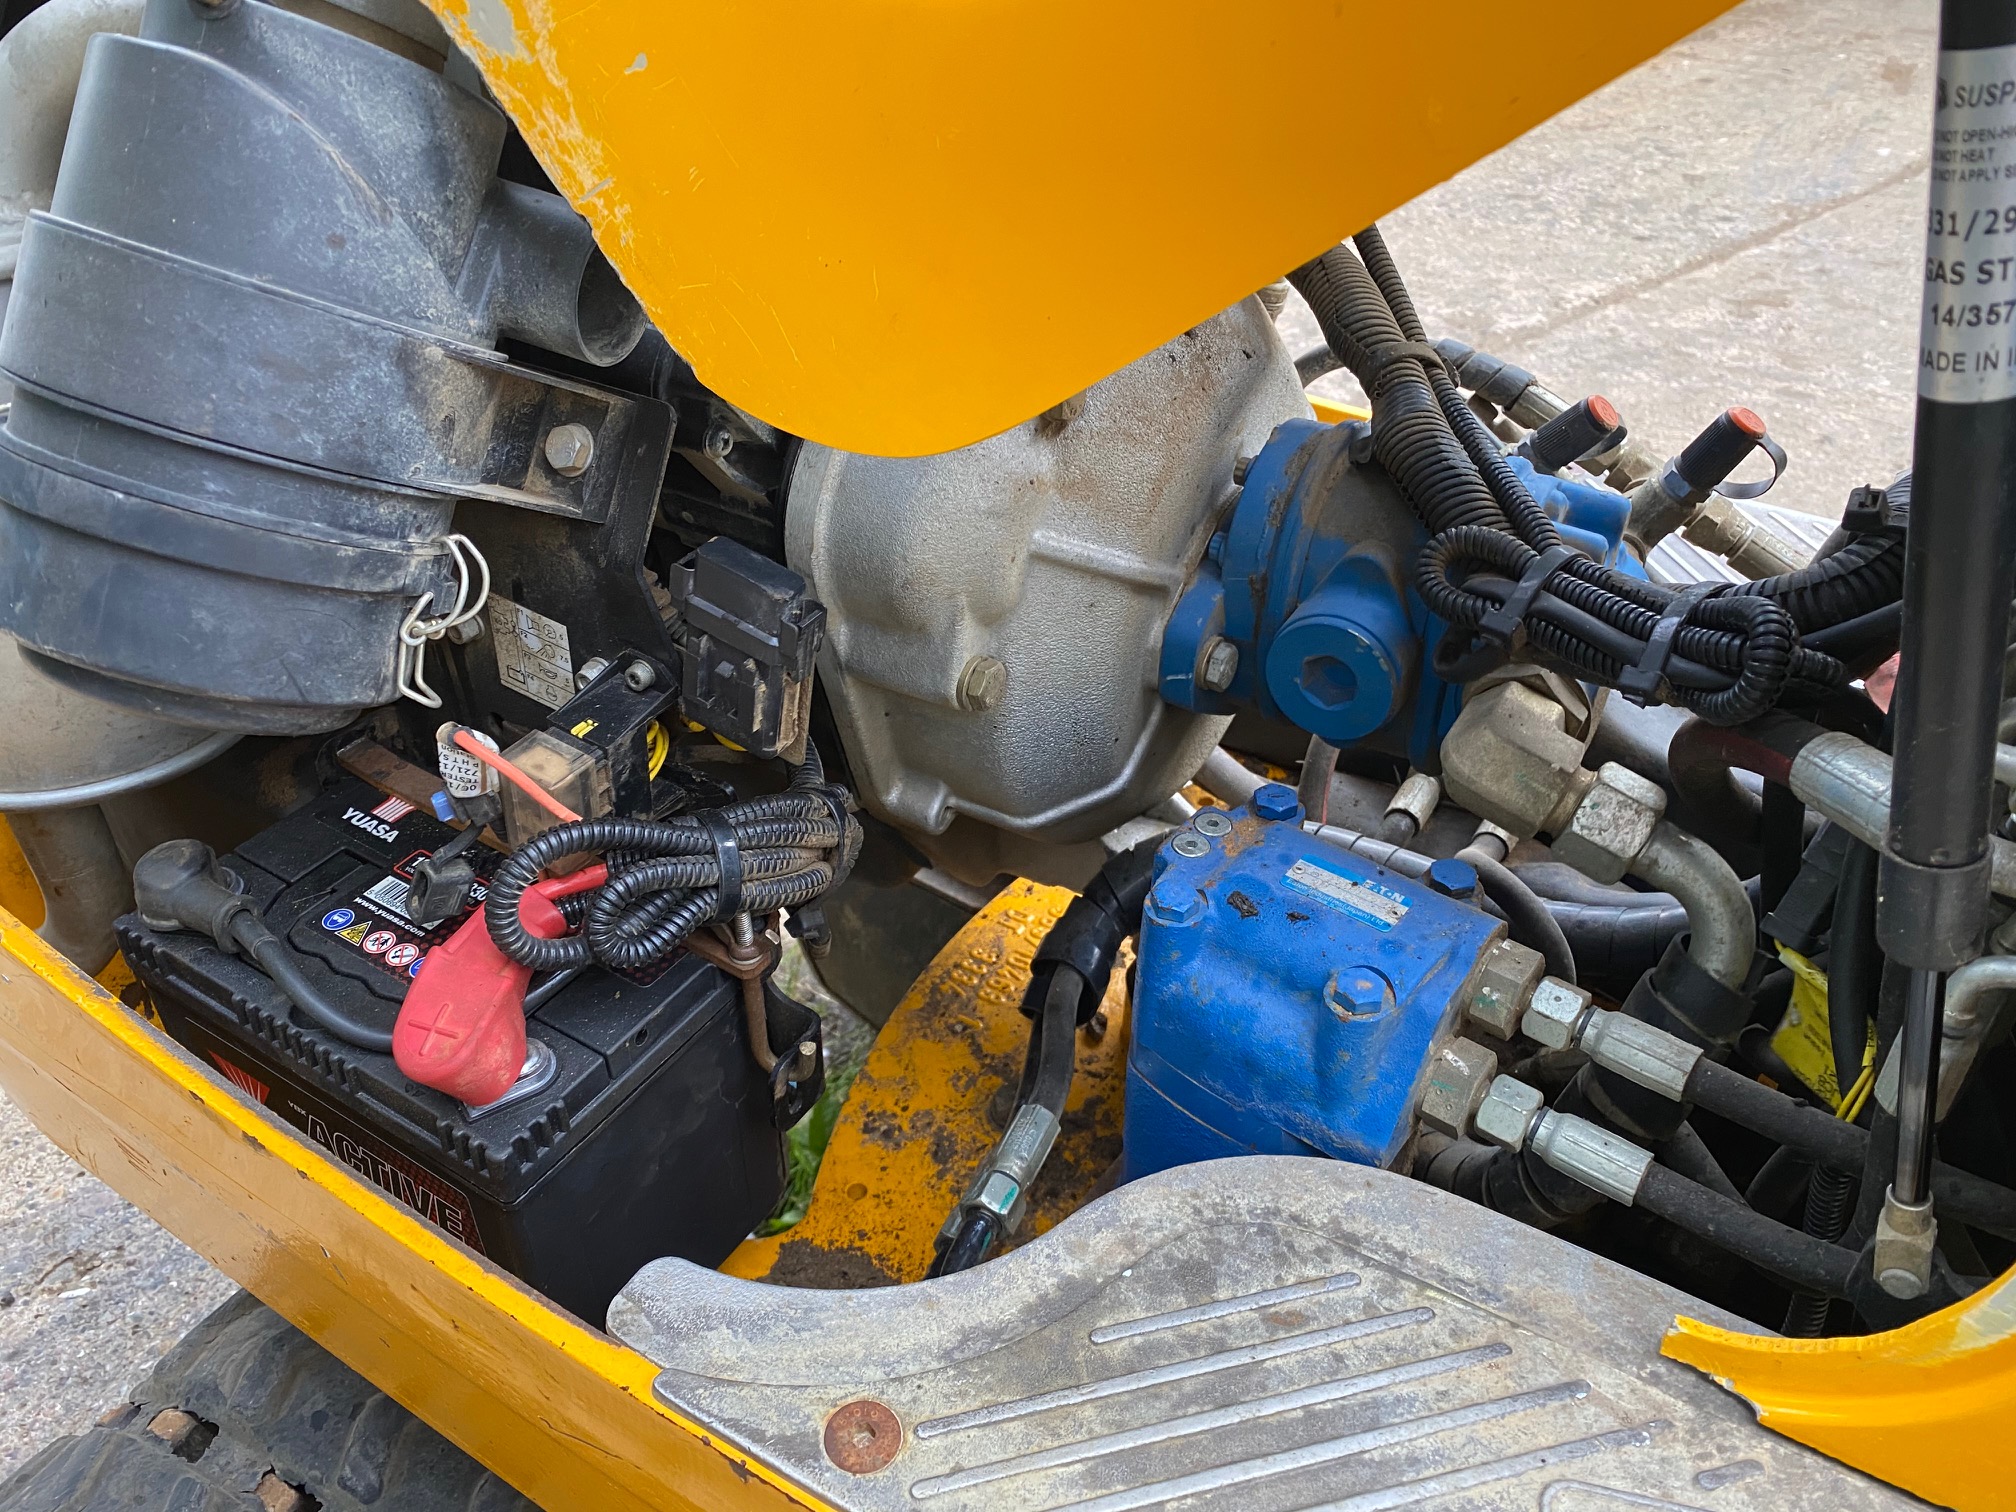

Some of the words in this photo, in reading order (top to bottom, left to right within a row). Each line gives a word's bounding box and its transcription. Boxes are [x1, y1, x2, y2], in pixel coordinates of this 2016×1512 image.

[1953, 80, 2016, 108] SUSP
[1976, 256, 2016, 285] ST
[1975, 351, 1999, 372] IN
[341, 807, 400, 843] YUASA
[353, 896, 426, 938] www.yuasa.com
[287, 1100, 307, 1117] YBX
[308, 1114, 466, 1244] ACTIVE
